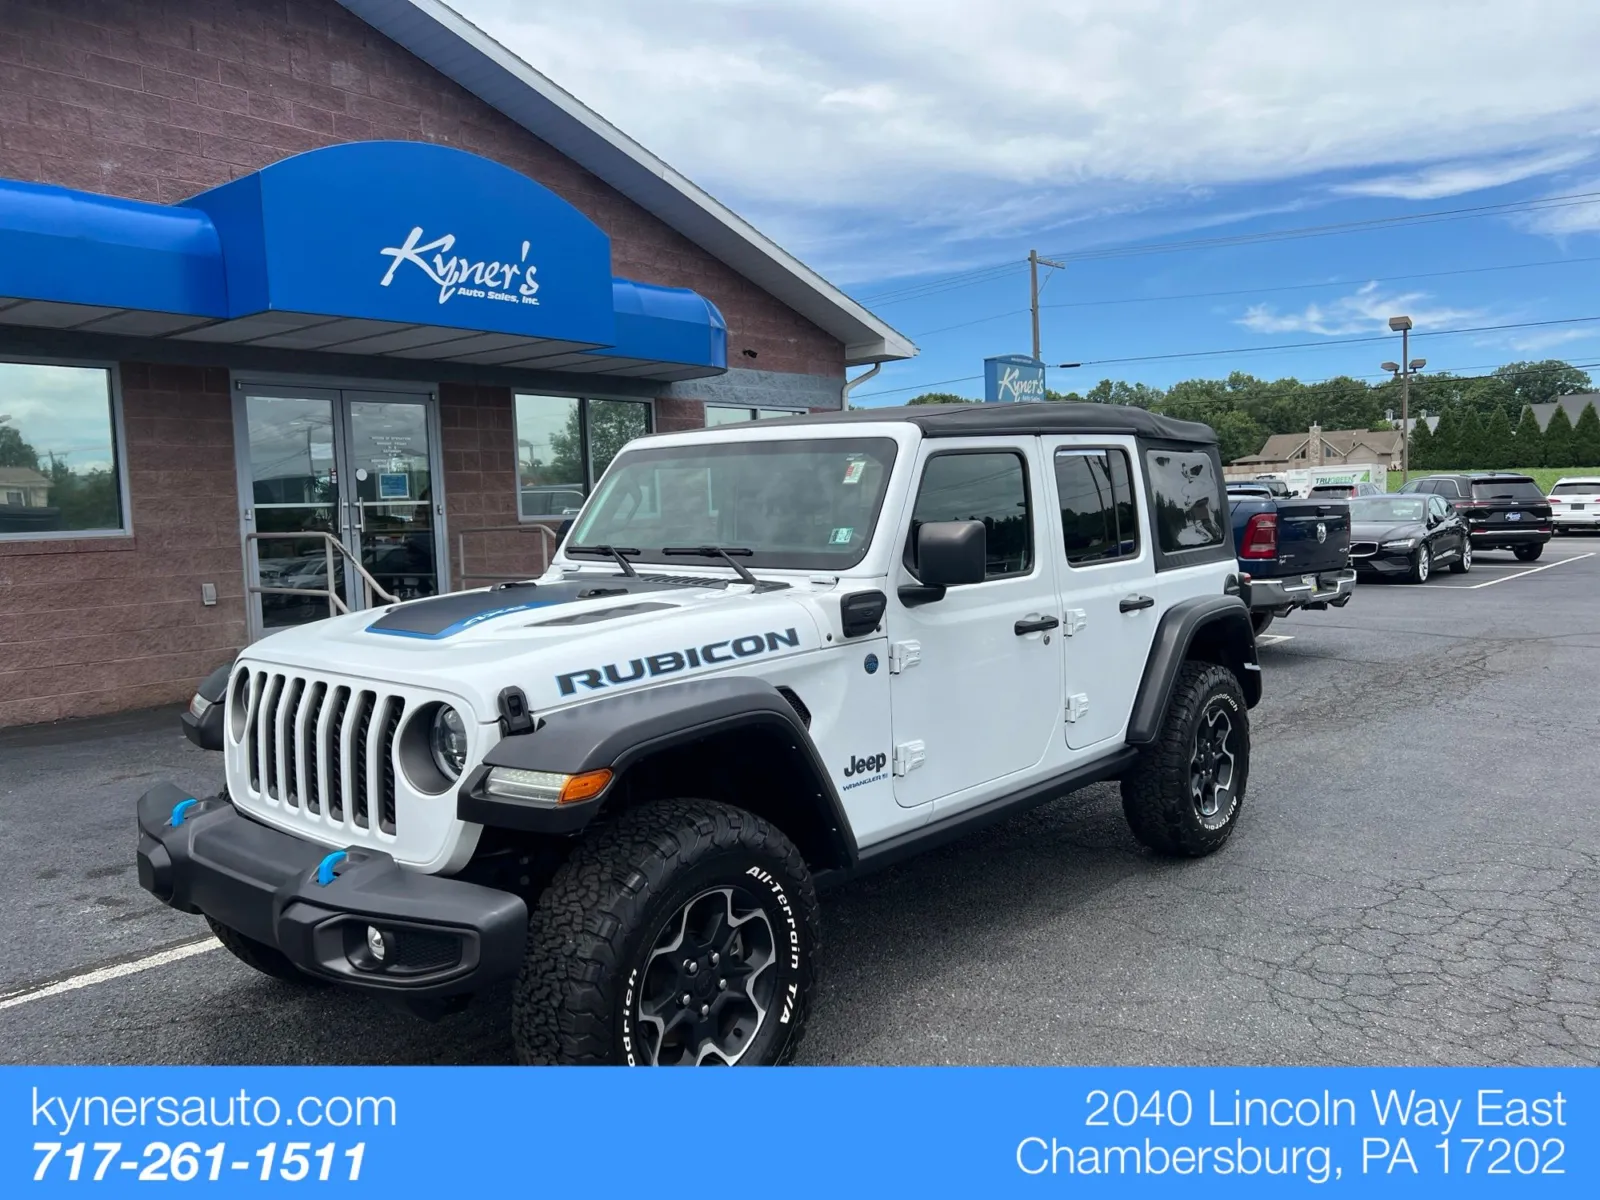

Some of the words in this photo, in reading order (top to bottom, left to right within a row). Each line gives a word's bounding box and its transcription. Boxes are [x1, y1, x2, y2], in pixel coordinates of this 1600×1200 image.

[380, 226, 539, 304] Kyner's
[457, 287, 486, 298] Auto
[487, 291, 519, 303] Sales,
[521, 295, 540, 305] Inc.
[998, 367, 1044, 402] Kyner's
[555, 627, 800, 697] RUBICON
[844, 752, 887, 777] Jeep
[746, 866, 800, 969] All-Terrain
[780, 983, 798, 1024] T/A
